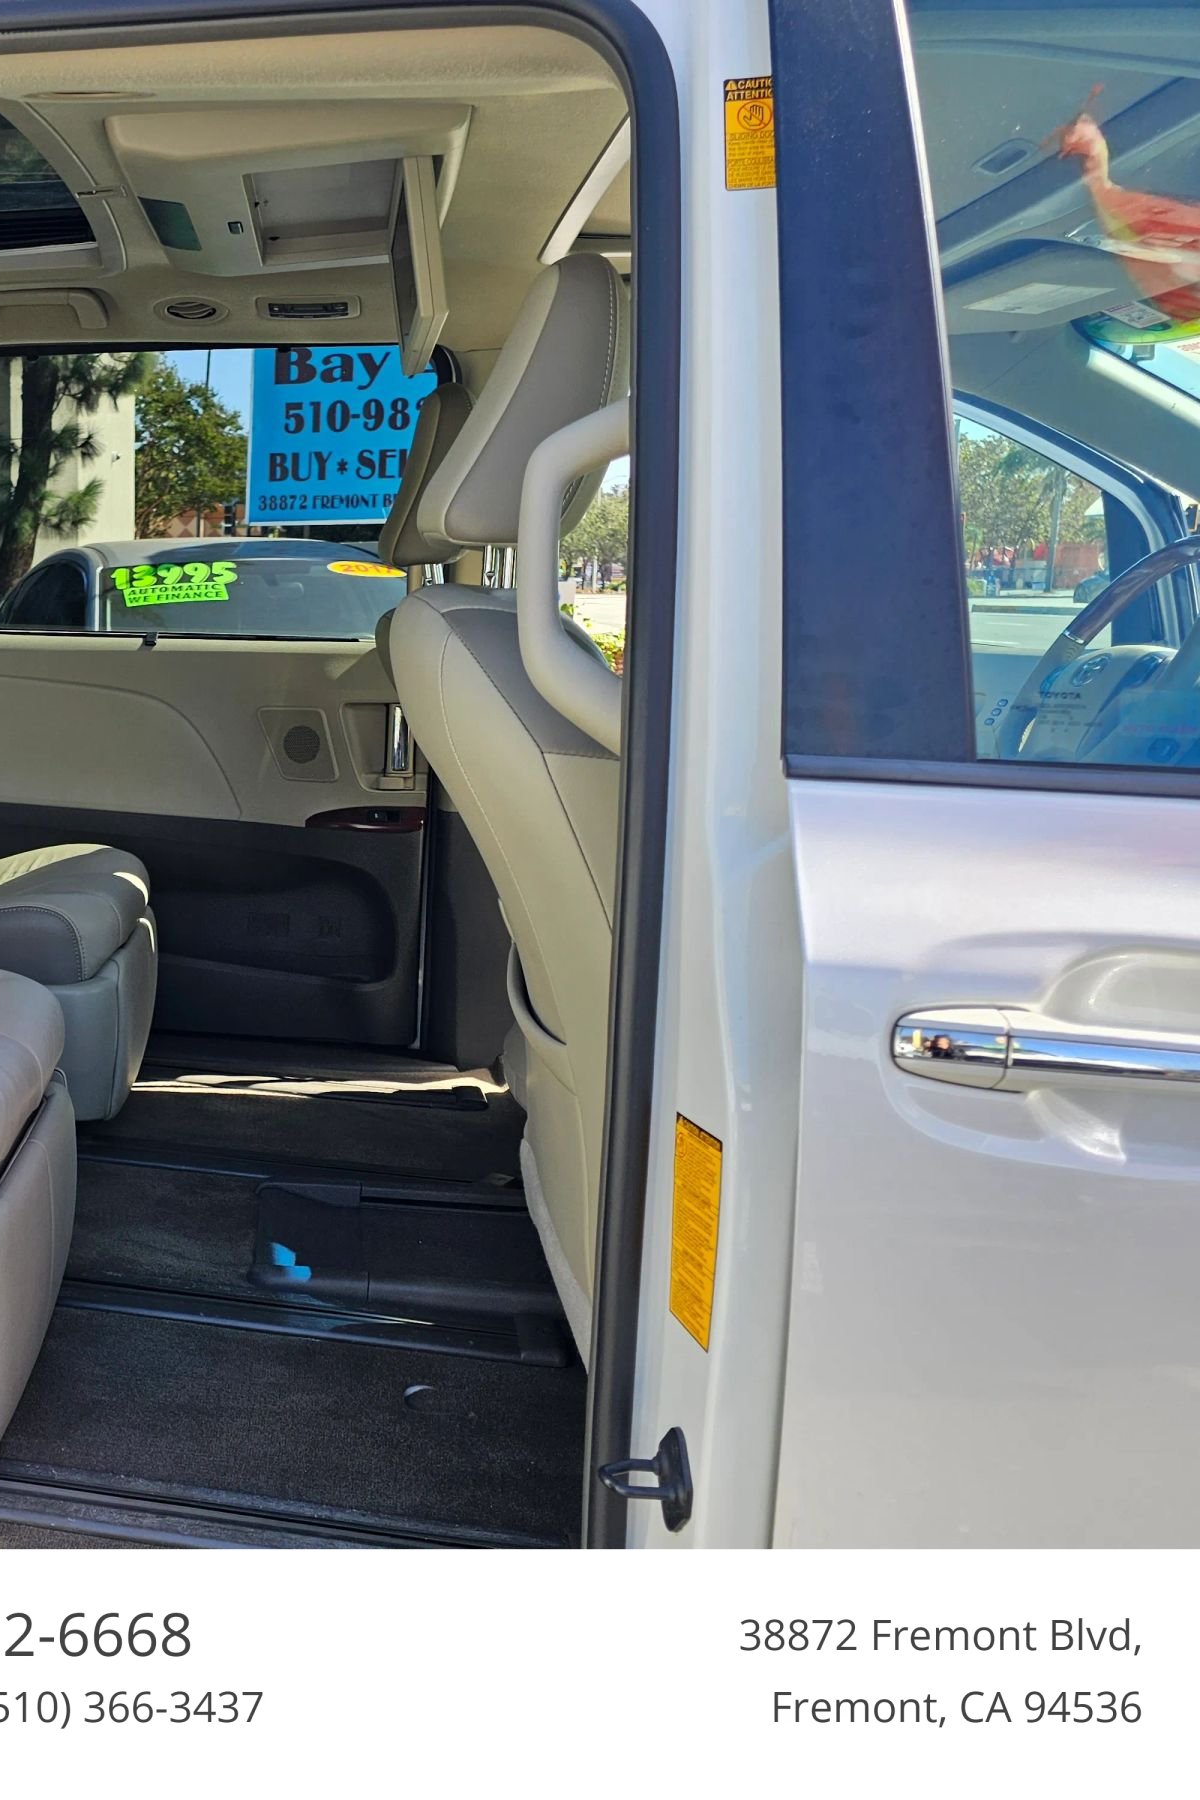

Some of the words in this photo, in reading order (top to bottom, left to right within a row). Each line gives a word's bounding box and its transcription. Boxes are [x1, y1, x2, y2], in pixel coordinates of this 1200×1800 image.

[274, 346, 391, 391] Bay
[284, 397, 425, 434] 510-98
[268, 451, 333, 482] BUY
[258, 494, 308, 512] 38872
[312, 493, 380, 510] FREMONT
[383, 493, 399, 508] B
[111, 561, 238, 590] 13995
[128, 583, 221, 596] AUTOMATIC
[128, 595, 151, 604] WE
[157, 591, 222, 601] FINANCE
